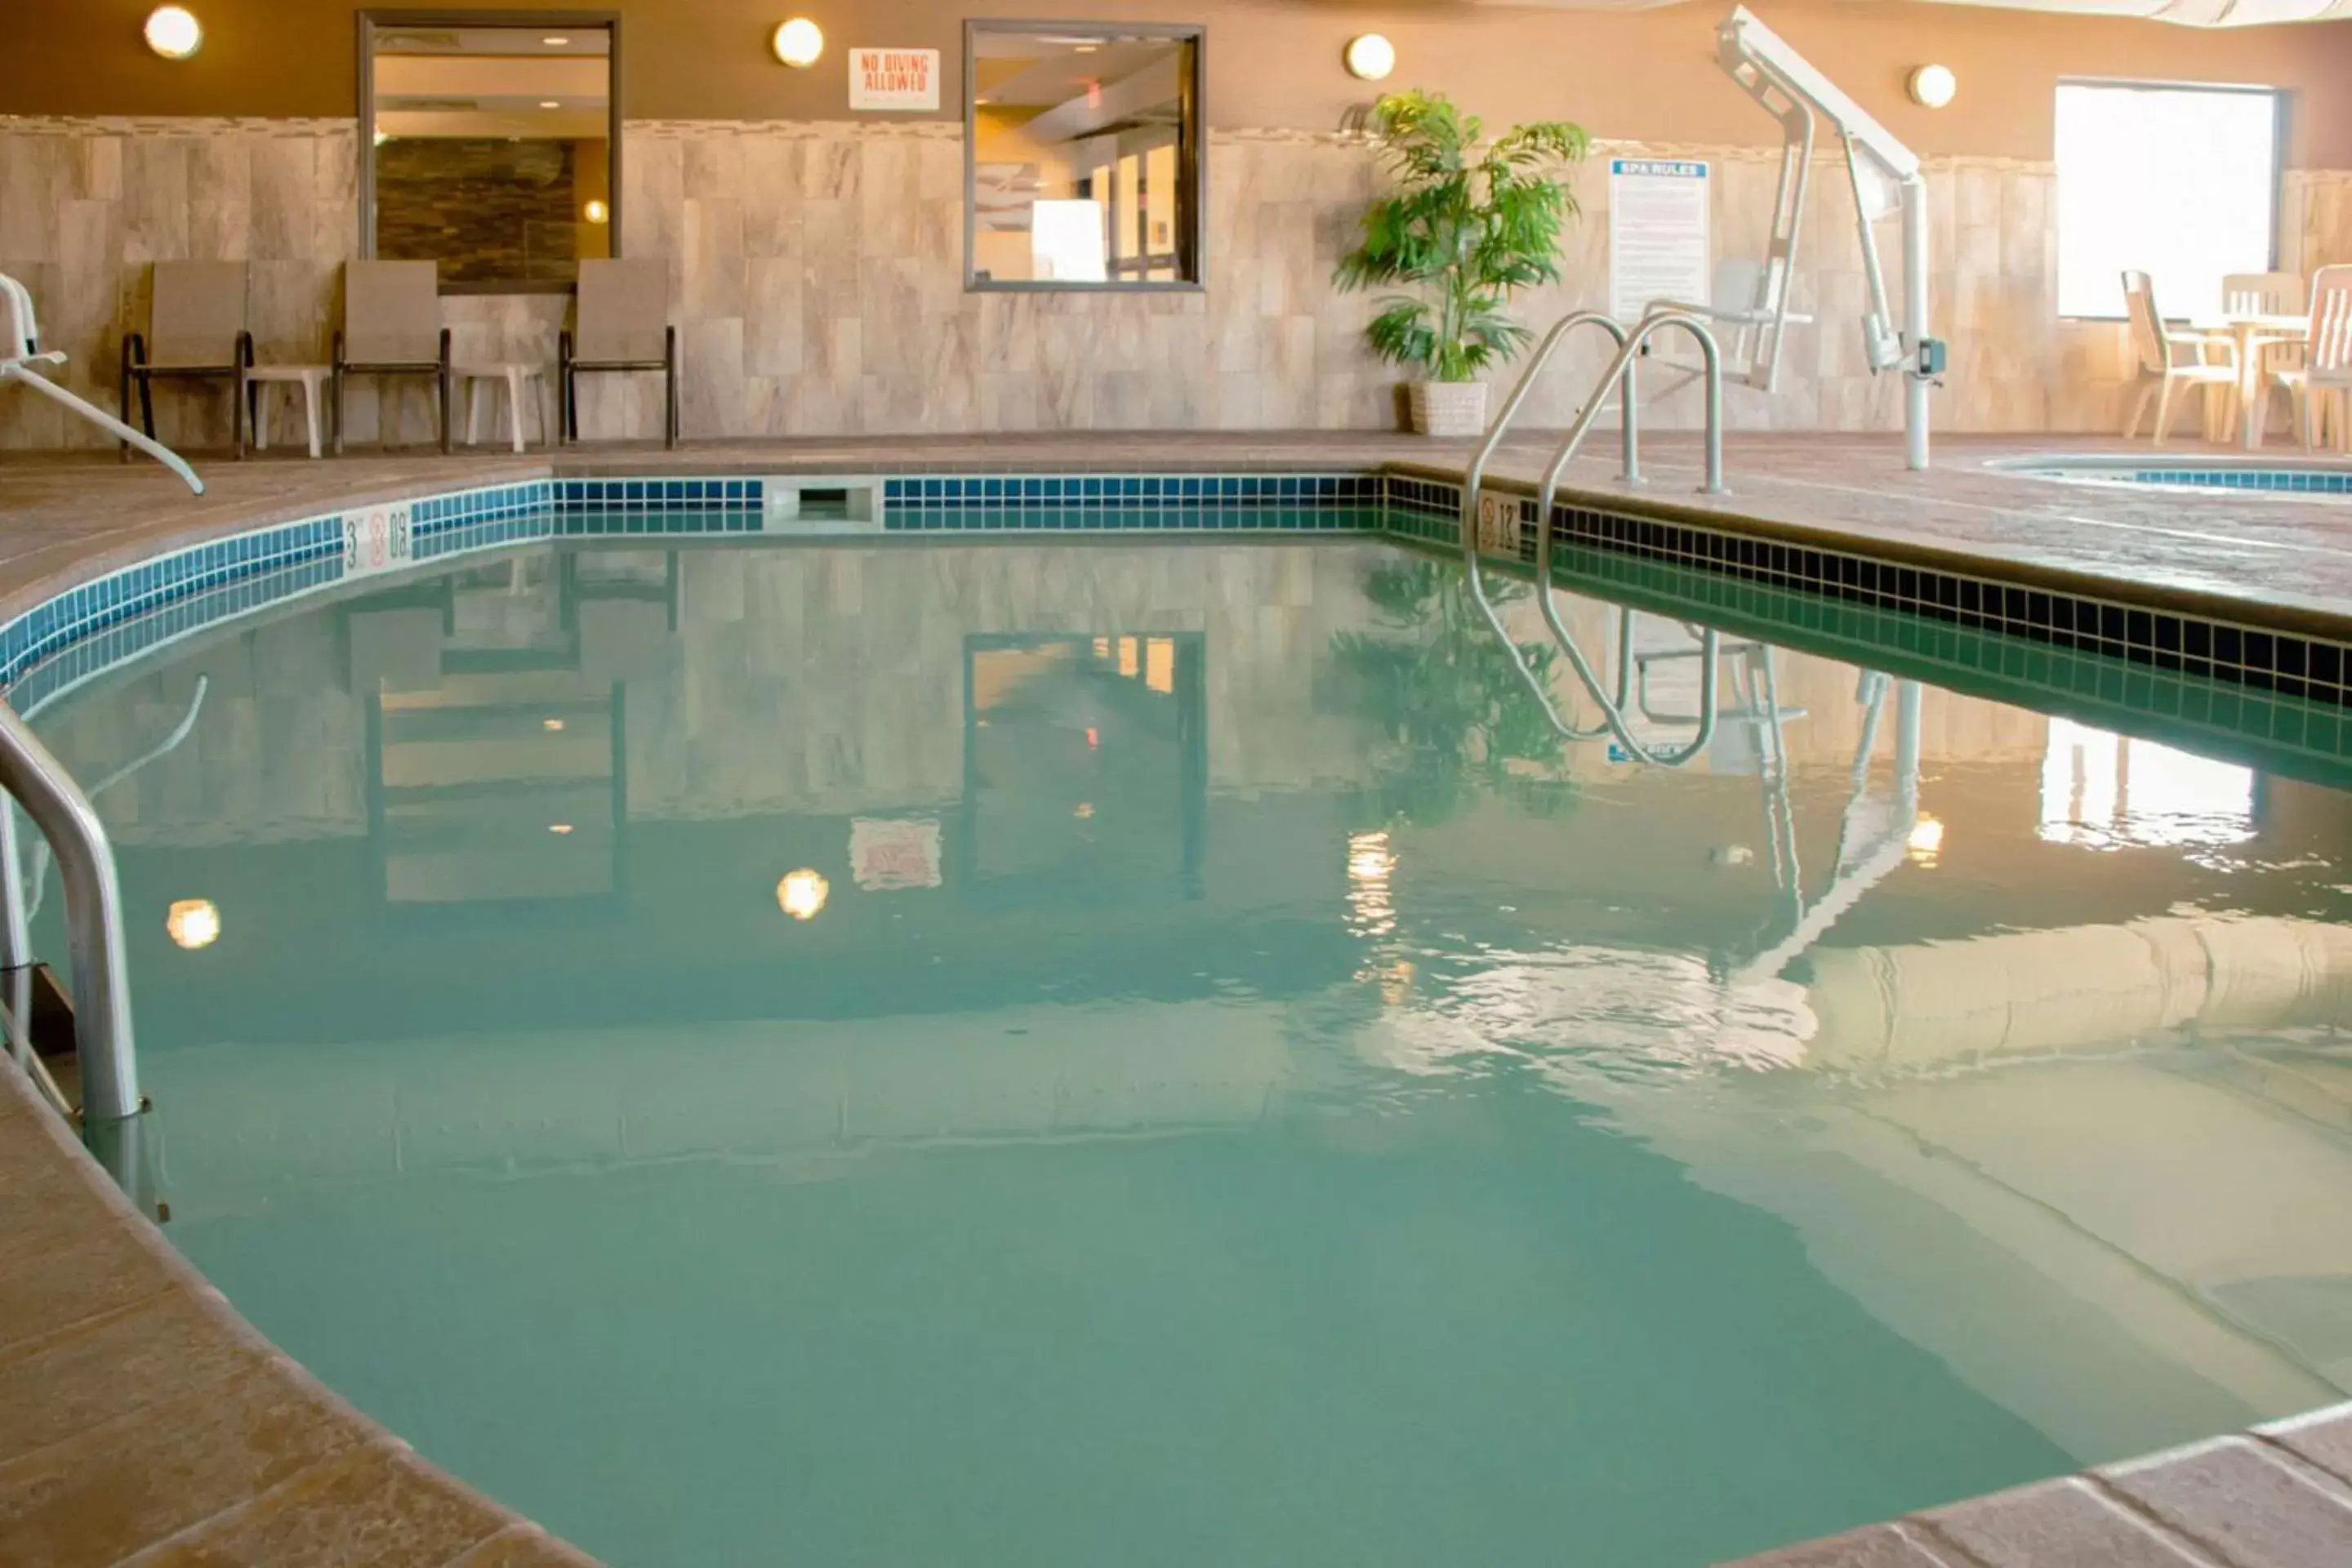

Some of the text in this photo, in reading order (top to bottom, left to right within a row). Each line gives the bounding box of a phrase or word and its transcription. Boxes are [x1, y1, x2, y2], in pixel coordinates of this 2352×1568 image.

[862, 54, 929, 72] NO DIVING
[864, 72, 926, 91] ALLOWED
[1620, 163, 1695, 176] SPA RULES
